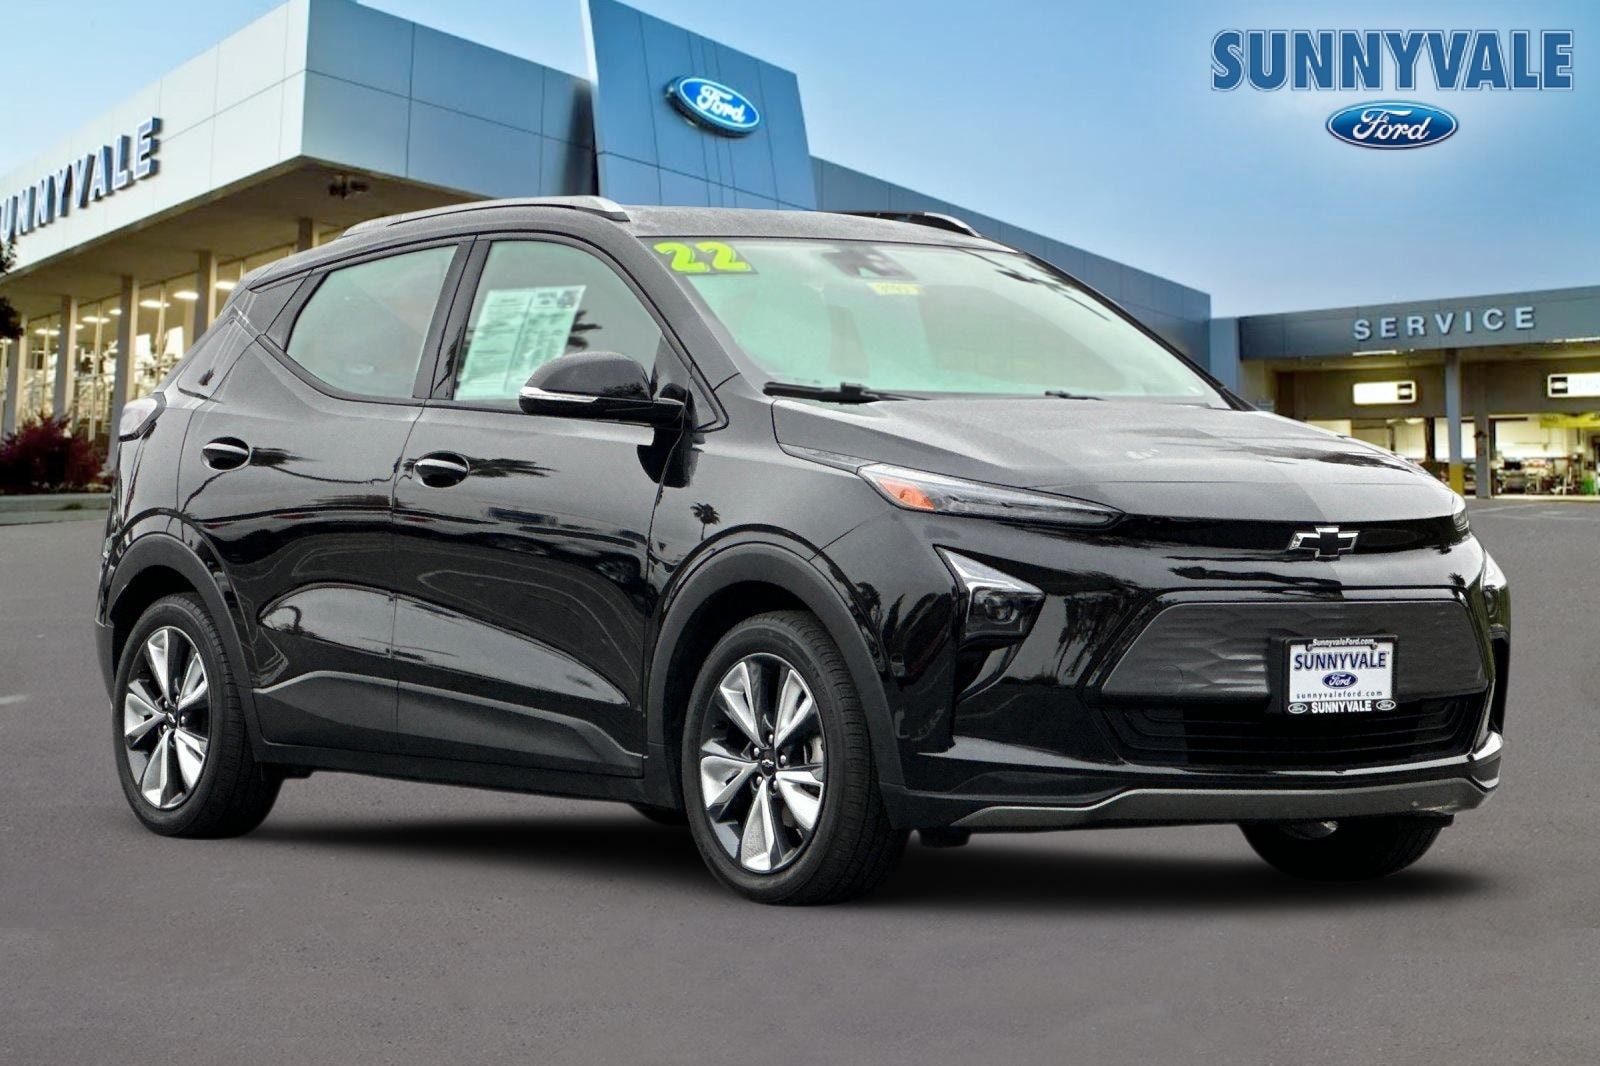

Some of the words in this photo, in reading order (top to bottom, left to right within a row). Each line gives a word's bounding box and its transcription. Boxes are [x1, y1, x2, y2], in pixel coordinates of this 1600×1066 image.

[697, 85, 746, 123] Ford
[0, 116, 162, 244] UNNYVALE
[653, 241, 752, 273] 22
[1353, 306, 1535, 340] SERVICE
[1294, 652, 1387, 671] SUNNYVALE
[1329, 674, 1352, 686] Ford
[1296, 690, 1383, 699] sunnyvaleford.com
[1311, 700, 1373, 714] SUNNYVALE
